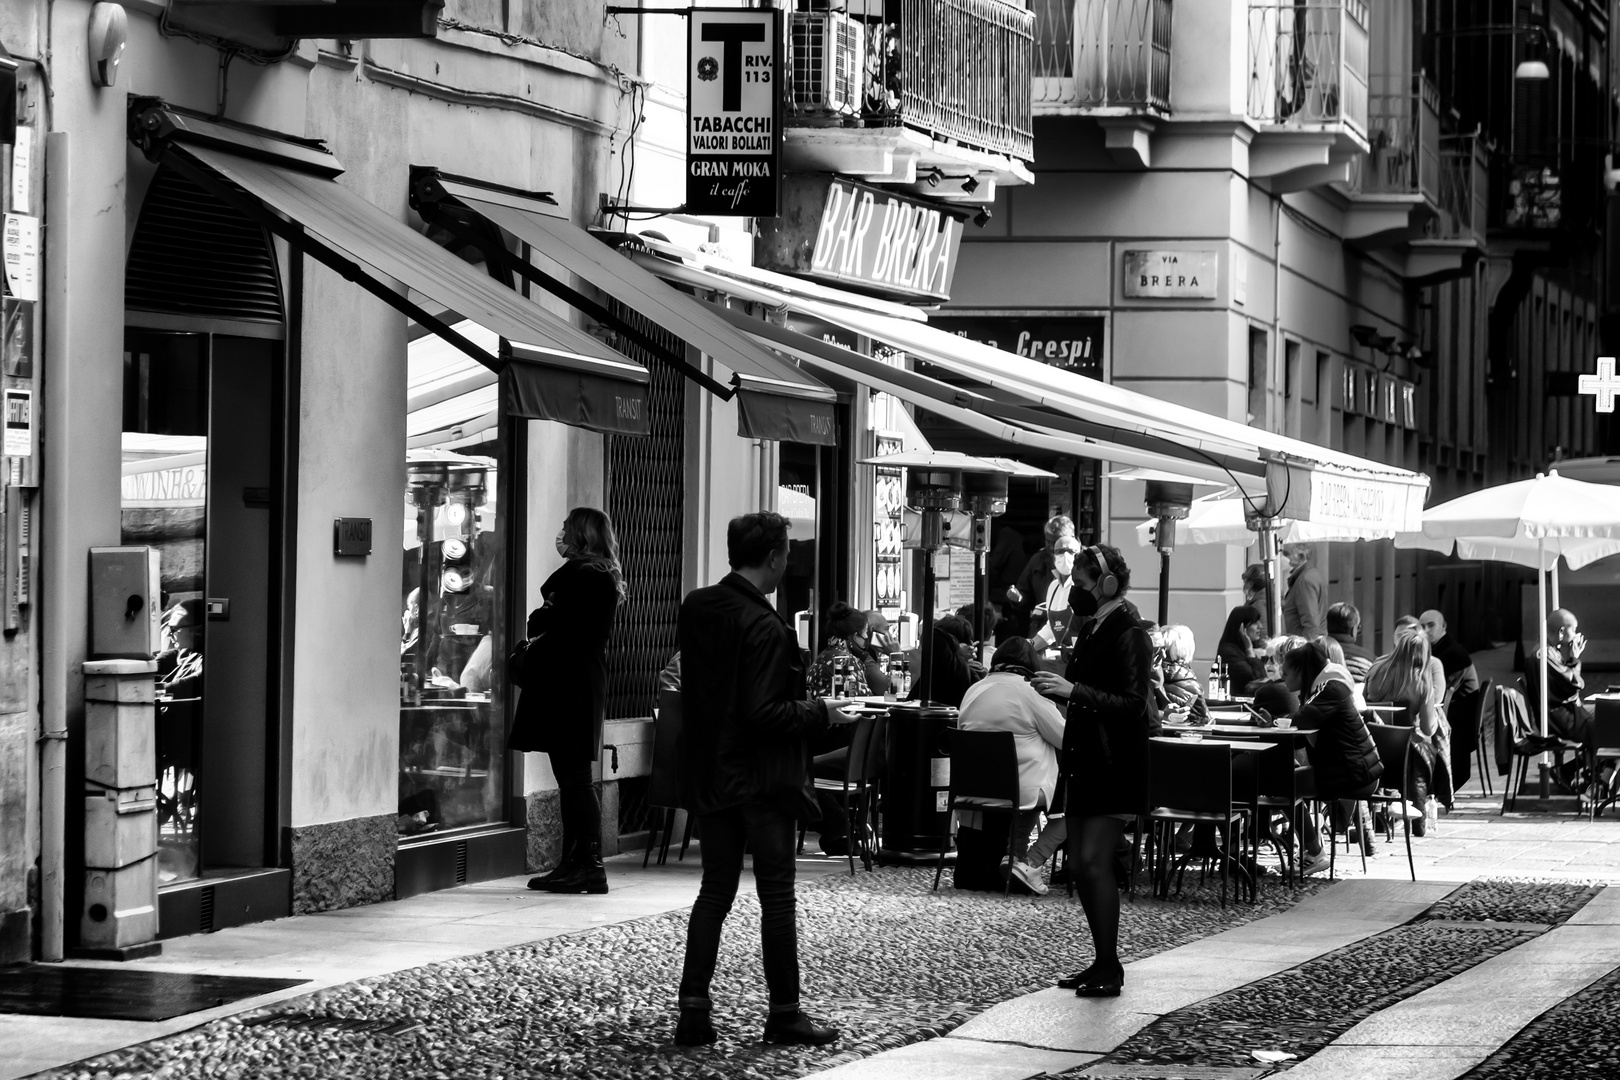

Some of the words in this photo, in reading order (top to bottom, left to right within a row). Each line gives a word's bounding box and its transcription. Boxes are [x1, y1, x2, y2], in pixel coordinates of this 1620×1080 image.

[701, 22, 766, 112] T
[745, 54, 773, 67] RIV.
[745, 71, 771, 83] 113
[693, 116, 771, 133] TABACCHI
[692, 135, 728, 150] VALORI
[731, 135, 771, 151] BOLLATI
[690, 160, 729, 177] GRAN
[731, 161, 771, 177] MOKA
[709, 182, 720, 196] il
[814, 182, 874, 277] BAR
[872, 197, 954, 294] BRERA
[1162, 256, 1178, 264] VIA
[1140, 274, 1199, 287] BRERA
